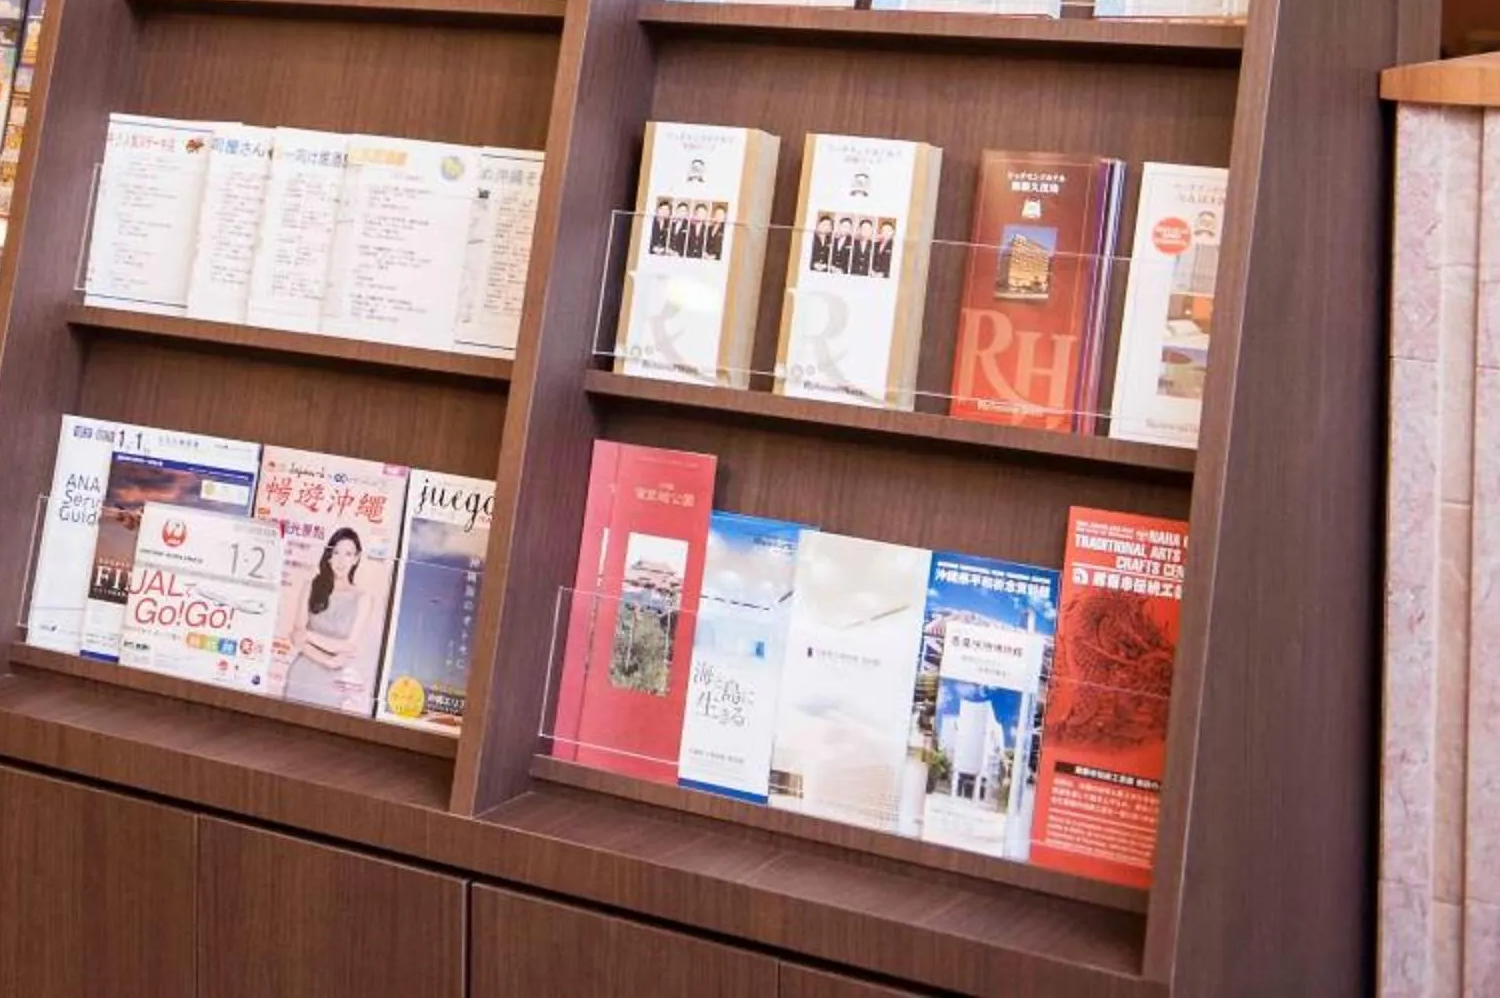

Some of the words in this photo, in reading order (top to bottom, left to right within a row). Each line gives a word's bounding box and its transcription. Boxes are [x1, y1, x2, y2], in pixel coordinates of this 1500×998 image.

[956, 307, 1079, 428] RH
[66, 474, 101, 493] ANA
[127, 569, 183, 597] JAL
[134, 597, 236, 630] Go!Go!
